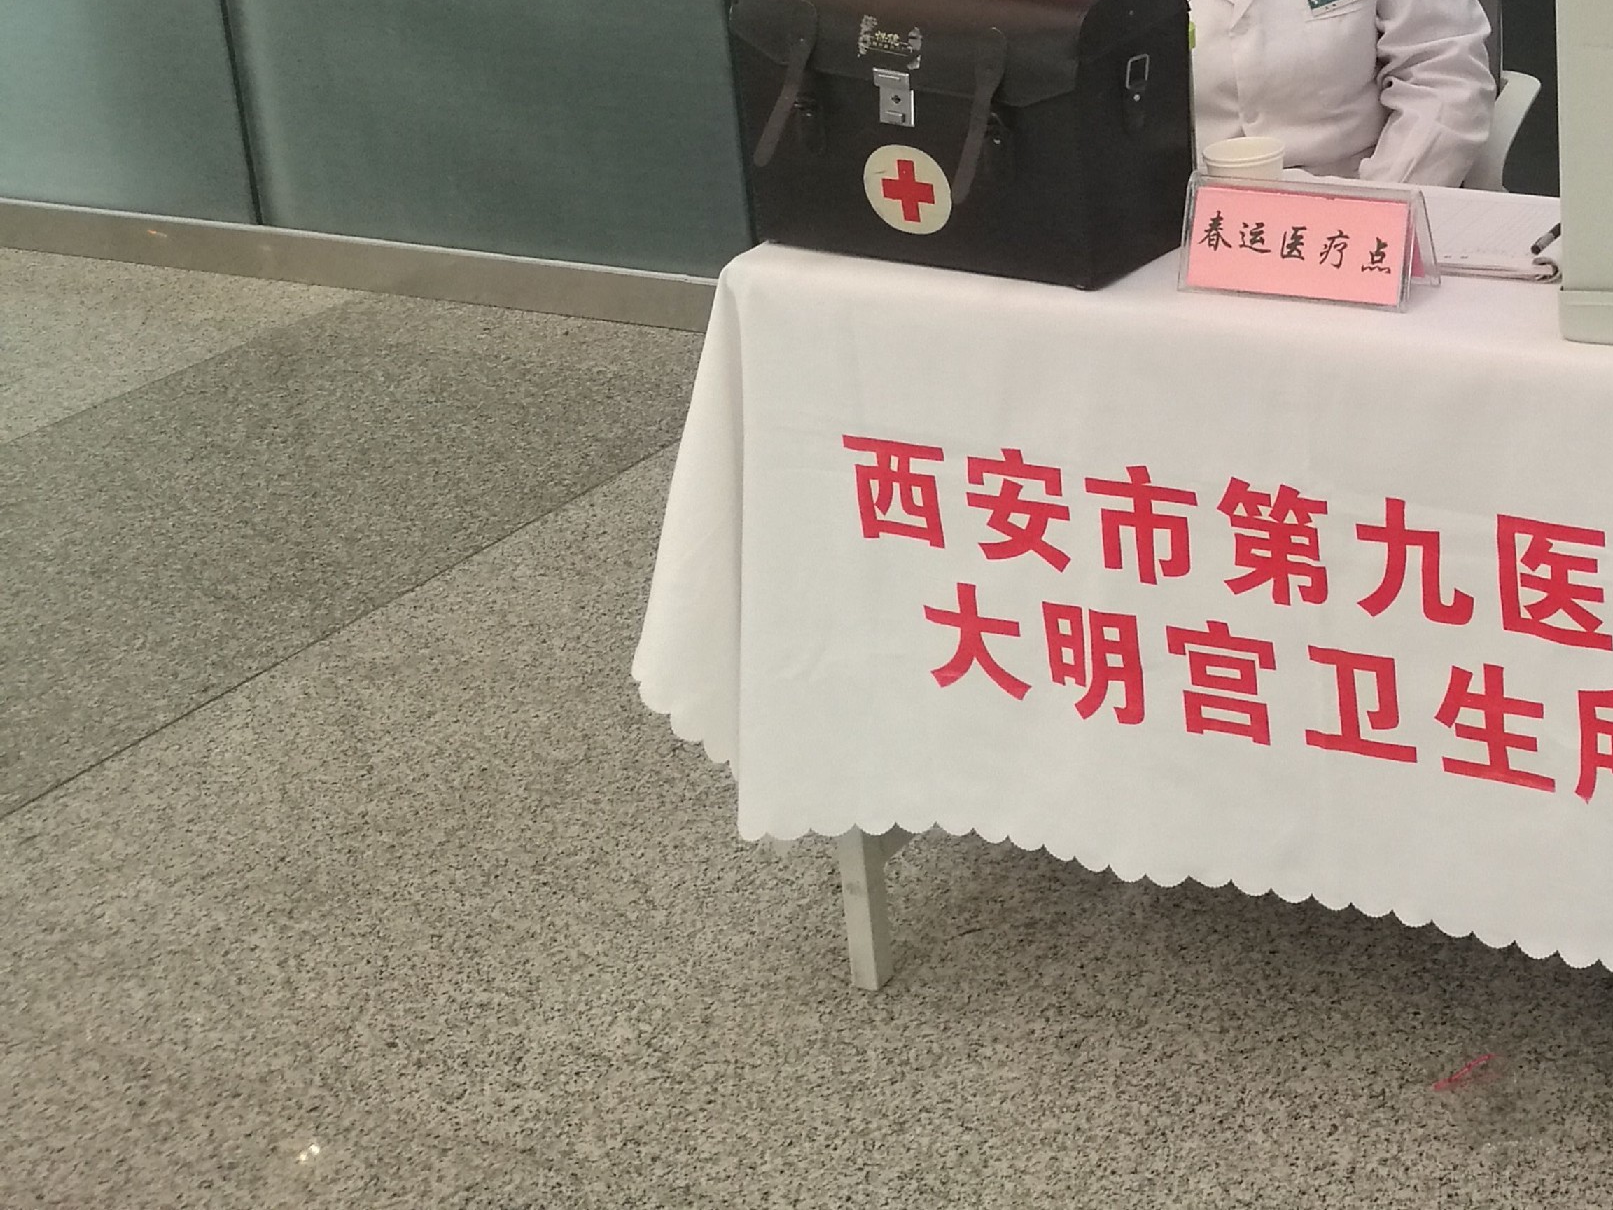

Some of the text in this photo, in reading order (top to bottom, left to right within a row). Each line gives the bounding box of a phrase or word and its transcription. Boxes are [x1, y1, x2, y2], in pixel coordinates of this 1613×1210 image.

[1198, 209, 1392, 275] 春运医疗点
